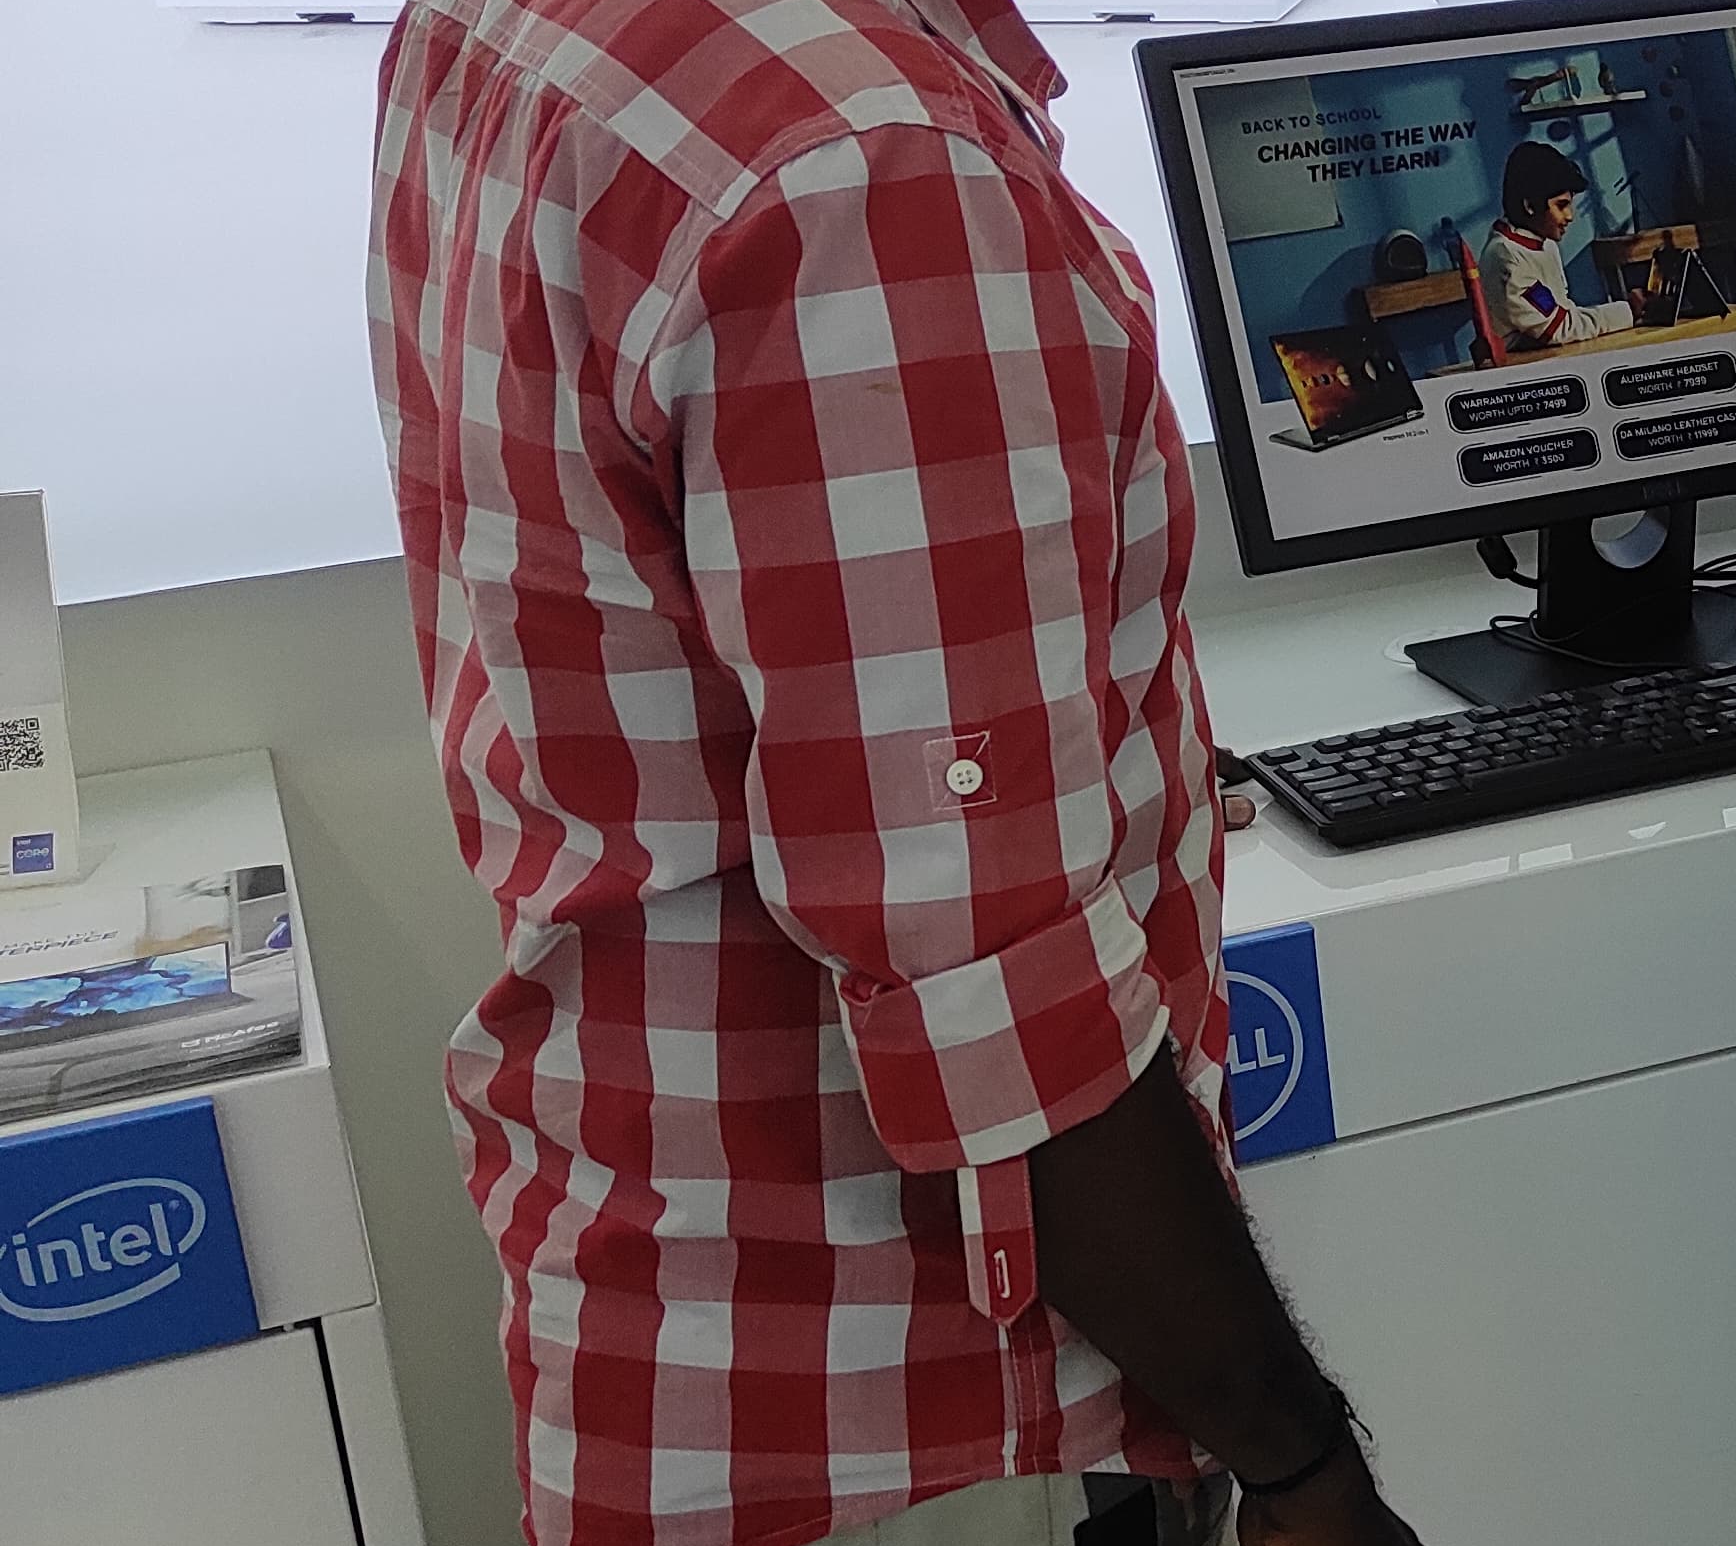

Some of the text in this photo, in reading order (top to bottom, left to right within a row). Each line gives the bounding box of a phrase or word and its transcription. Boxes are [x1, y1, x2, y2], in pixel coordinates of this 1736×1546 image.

[1241, 107, 1382, 134] BACK TO SCHOOL
[1257, 121, 1477, 163] CHANGING THE WAY
[1306, 151, 1440, 183] THEY LEARN
[1619, 360, 1718, 384] ALIENWARE HEADSET
[1458, 383, 1570, 409] WARRANTY UPGRADES
[1619, 428, 1633, 440] DA
[1633, 422, 1672, 436] MILANO
[1672, 415, 1716, 430] LEATHER
[1481, 438, 1574, 461] AMAZON VOUCHER
